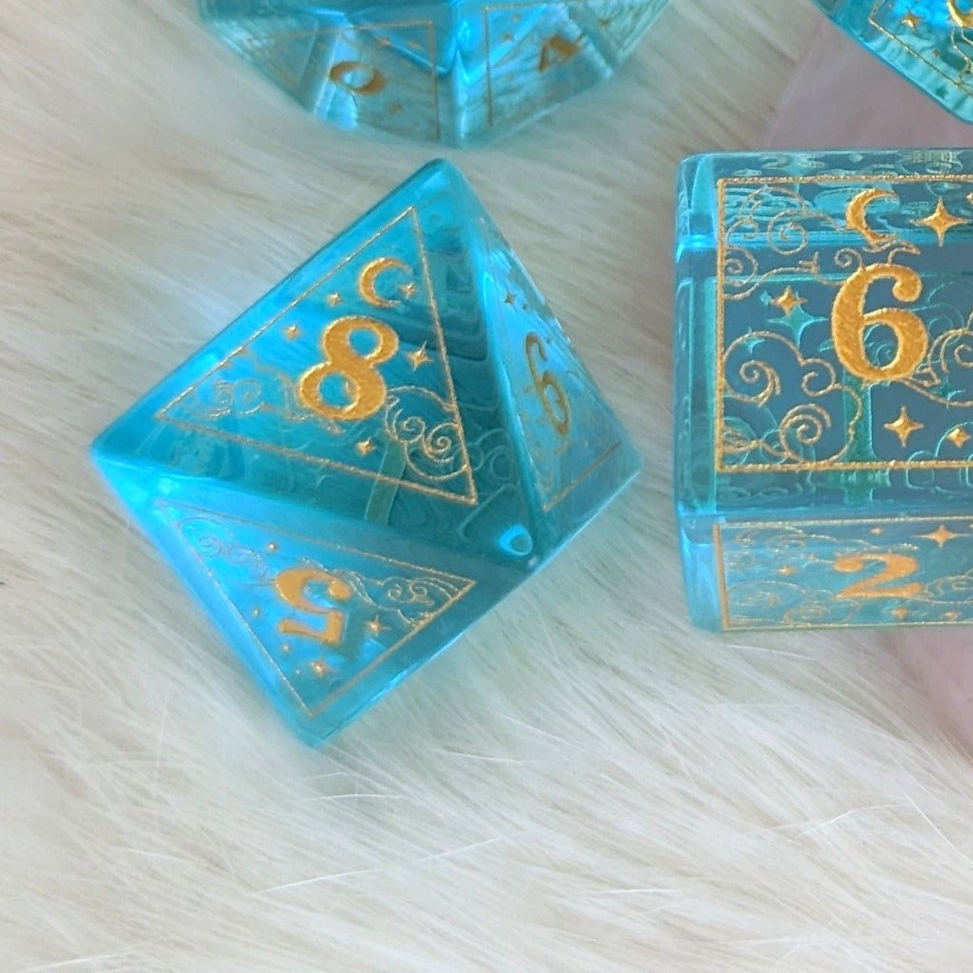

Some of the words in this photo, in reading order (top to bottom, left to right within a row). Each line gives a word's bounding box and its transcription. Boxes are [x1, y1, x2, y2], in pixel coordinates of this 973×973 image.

[299, 315, 400, 422] 8
[831, 263, 929, 384] 6
[523, 330, 572, 436] 6
[273, 567, 353, 646] 5
[833, 553, 922, 599] 2
